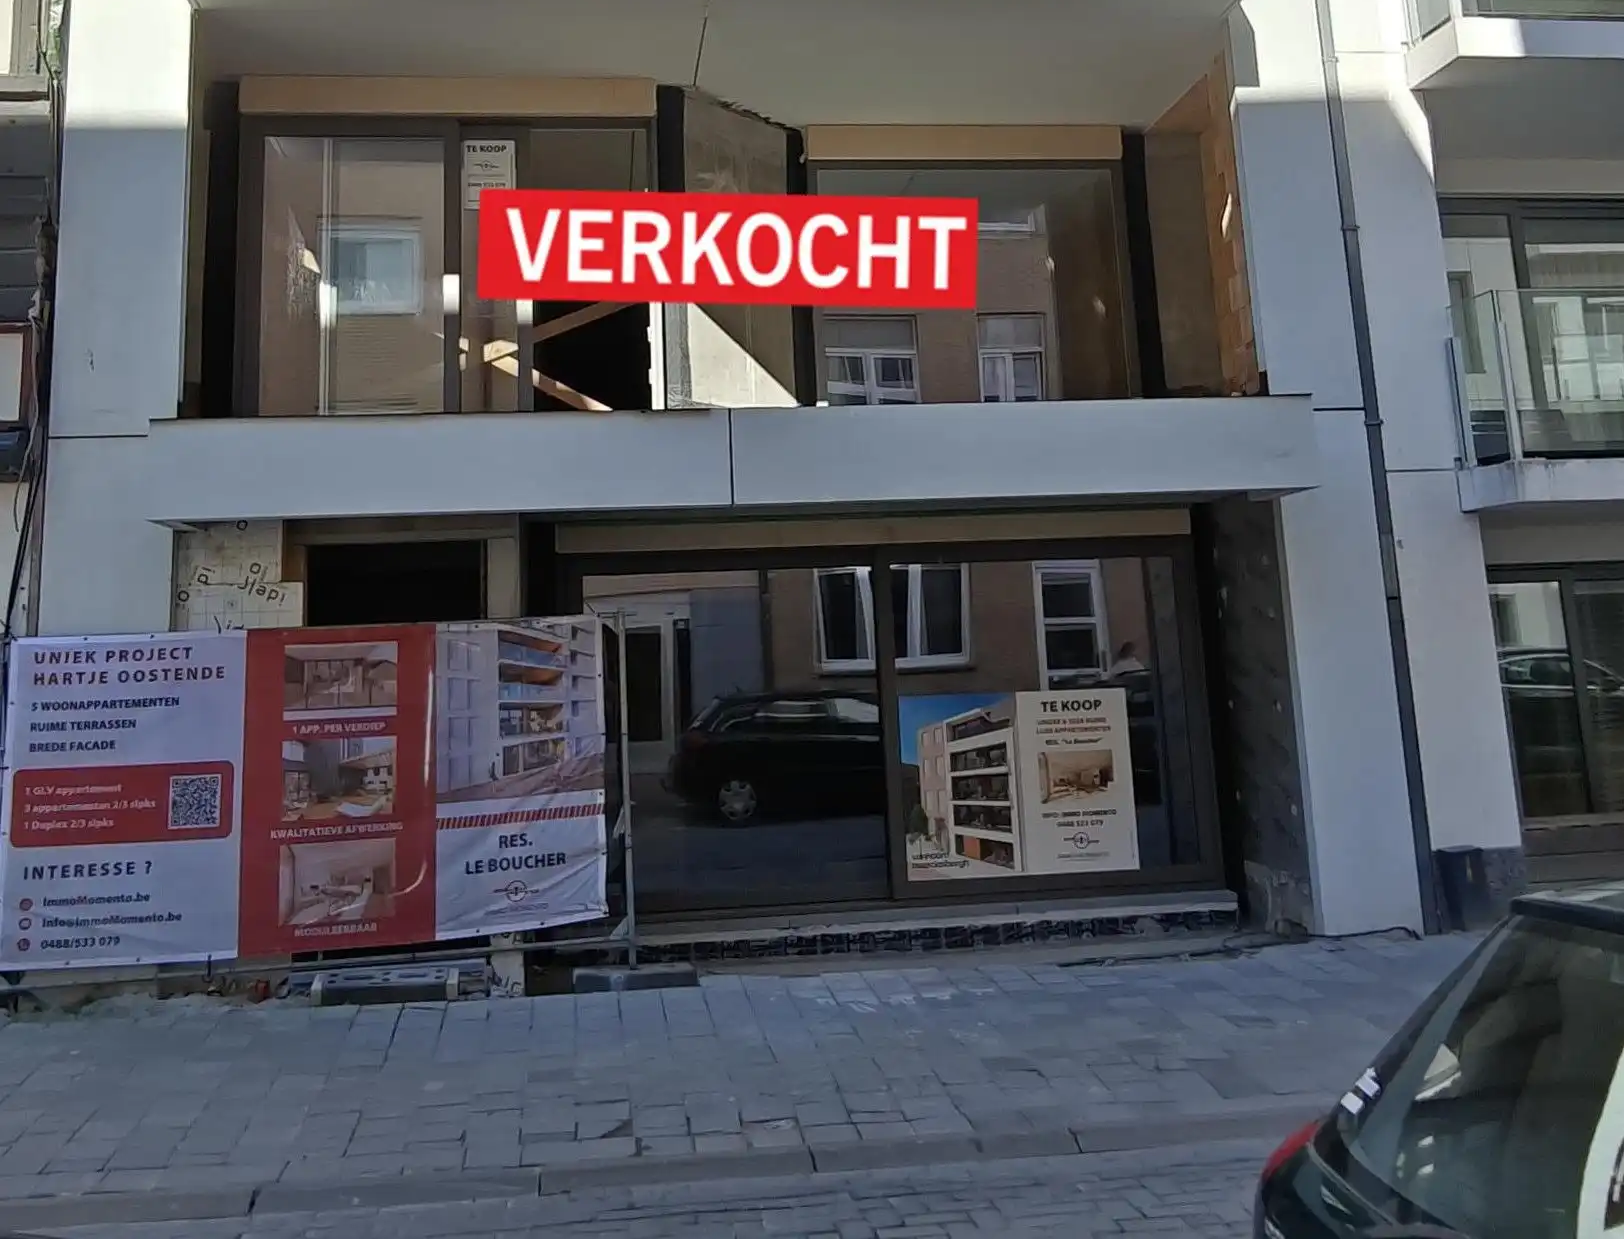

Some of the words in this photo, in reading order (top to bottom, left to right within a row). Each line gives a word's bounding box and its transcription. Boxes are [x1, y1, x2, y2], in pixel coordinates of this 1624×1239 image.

[480, 145, 507, 153] KOOP
[33, 649, 98, 665] UNIEK
[105, 646, 194, 663] PROJECT
[33, 670, 109, 686] HARTJE
[117, 666, 226, 684] OOSTENDE
[31, 702, 38, 712] 5
[40, 695, 180, 711] WOONAPPARTEMENTEN
[1041, 700, 1058, 713] TE
[1062, 699, 1102, 712] KOOP
[30, 721, 67, 733] RUIME
[70, 718, 137, 731] TERRASSEN
[29, 741, 67, 753] BREDE
[69, 740, 117, 752] FACADE
[32, 819, 68, 830] Duplex
[70, 819, 86, 829] 2/3
[270, 826, 343, 841] KWALITATIEVE
[498, 834, 534, 850] RES.
[23, 862, 136, 880] INTERESSE
[144, 860, 152, 874] ?
[464, 860, 486, 876] LE
[487, 852, 567, 873] BOUCHER
[40, 936, 96, 950] 0488/533
[99, 936, 120, 947] 079
